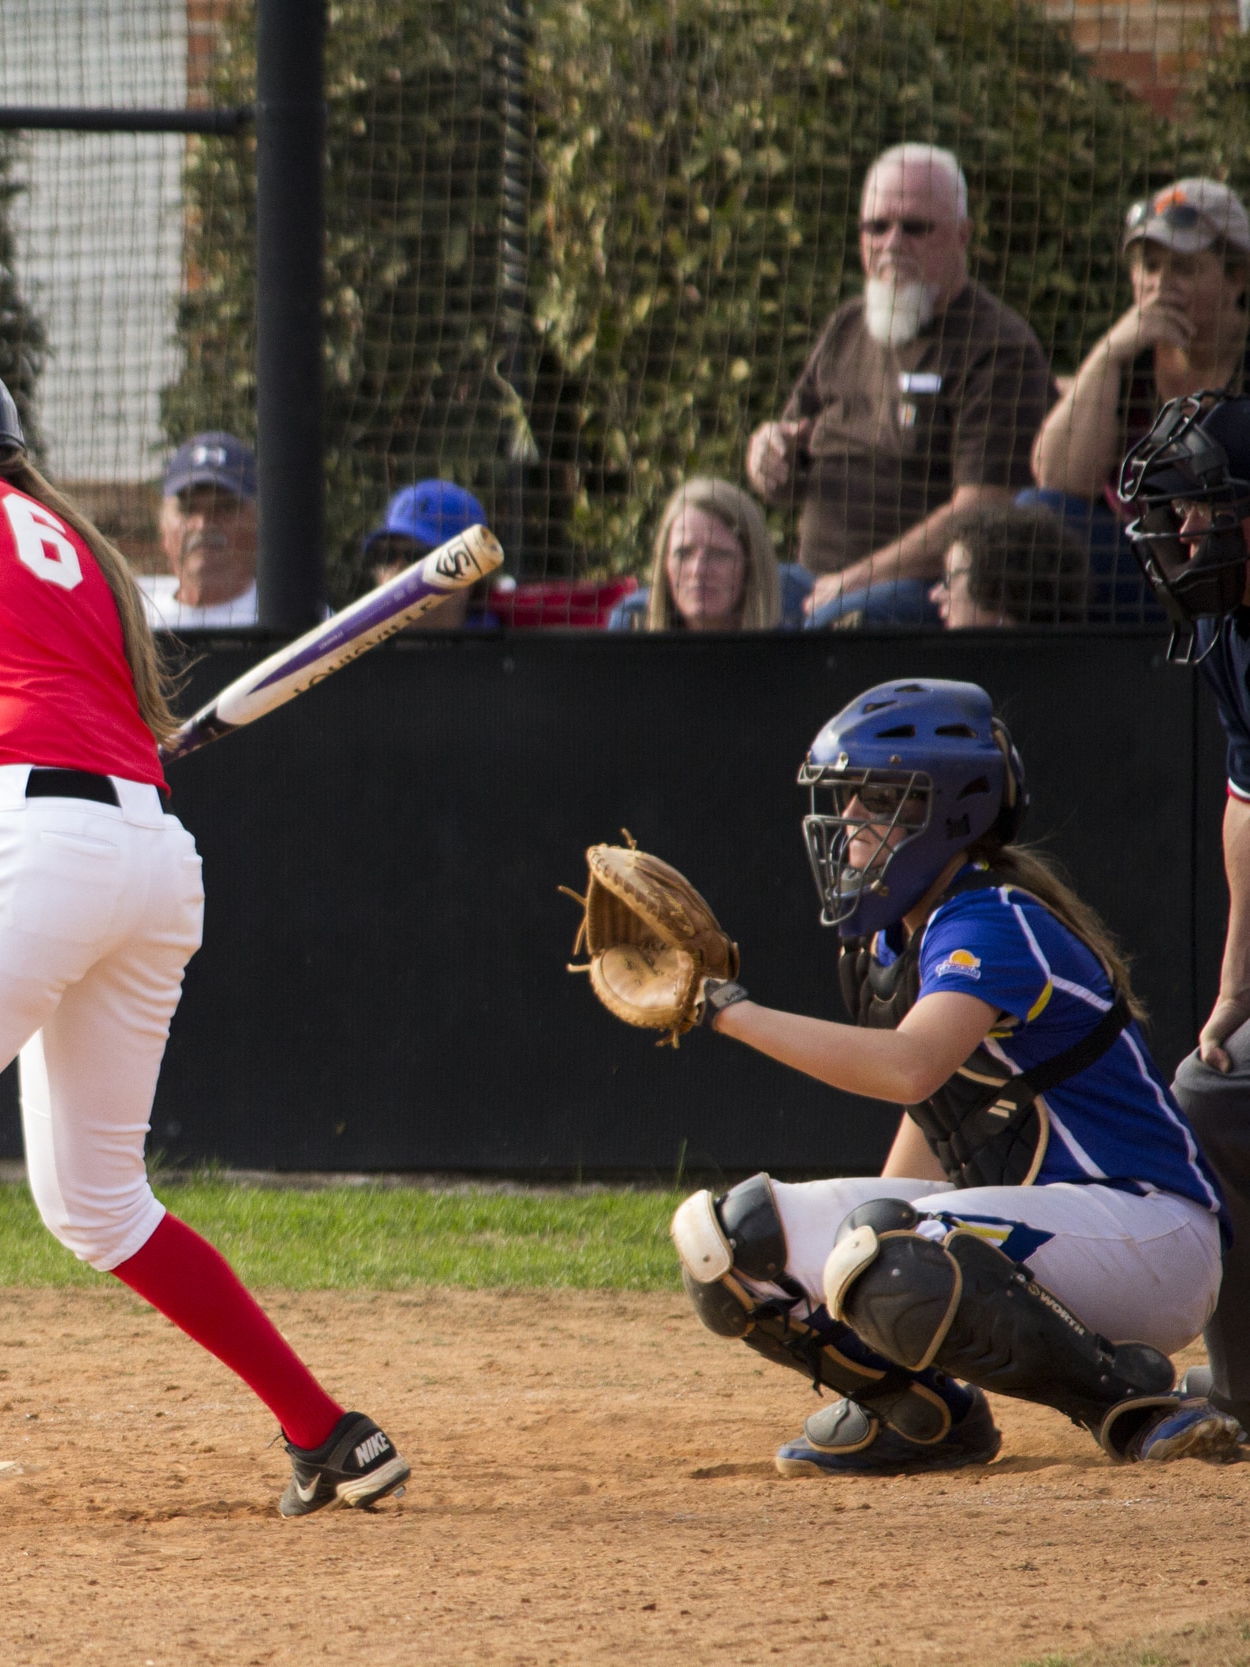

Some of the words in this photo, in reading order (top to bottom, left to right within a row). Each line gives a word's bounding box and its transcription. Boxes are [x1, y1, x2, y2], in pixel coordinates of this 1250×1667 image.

[2, 493, 83, 591] 6
[1040, 1292, 1085, 1336] WORTH
[354, 1431, 390, 1468] NIKE
